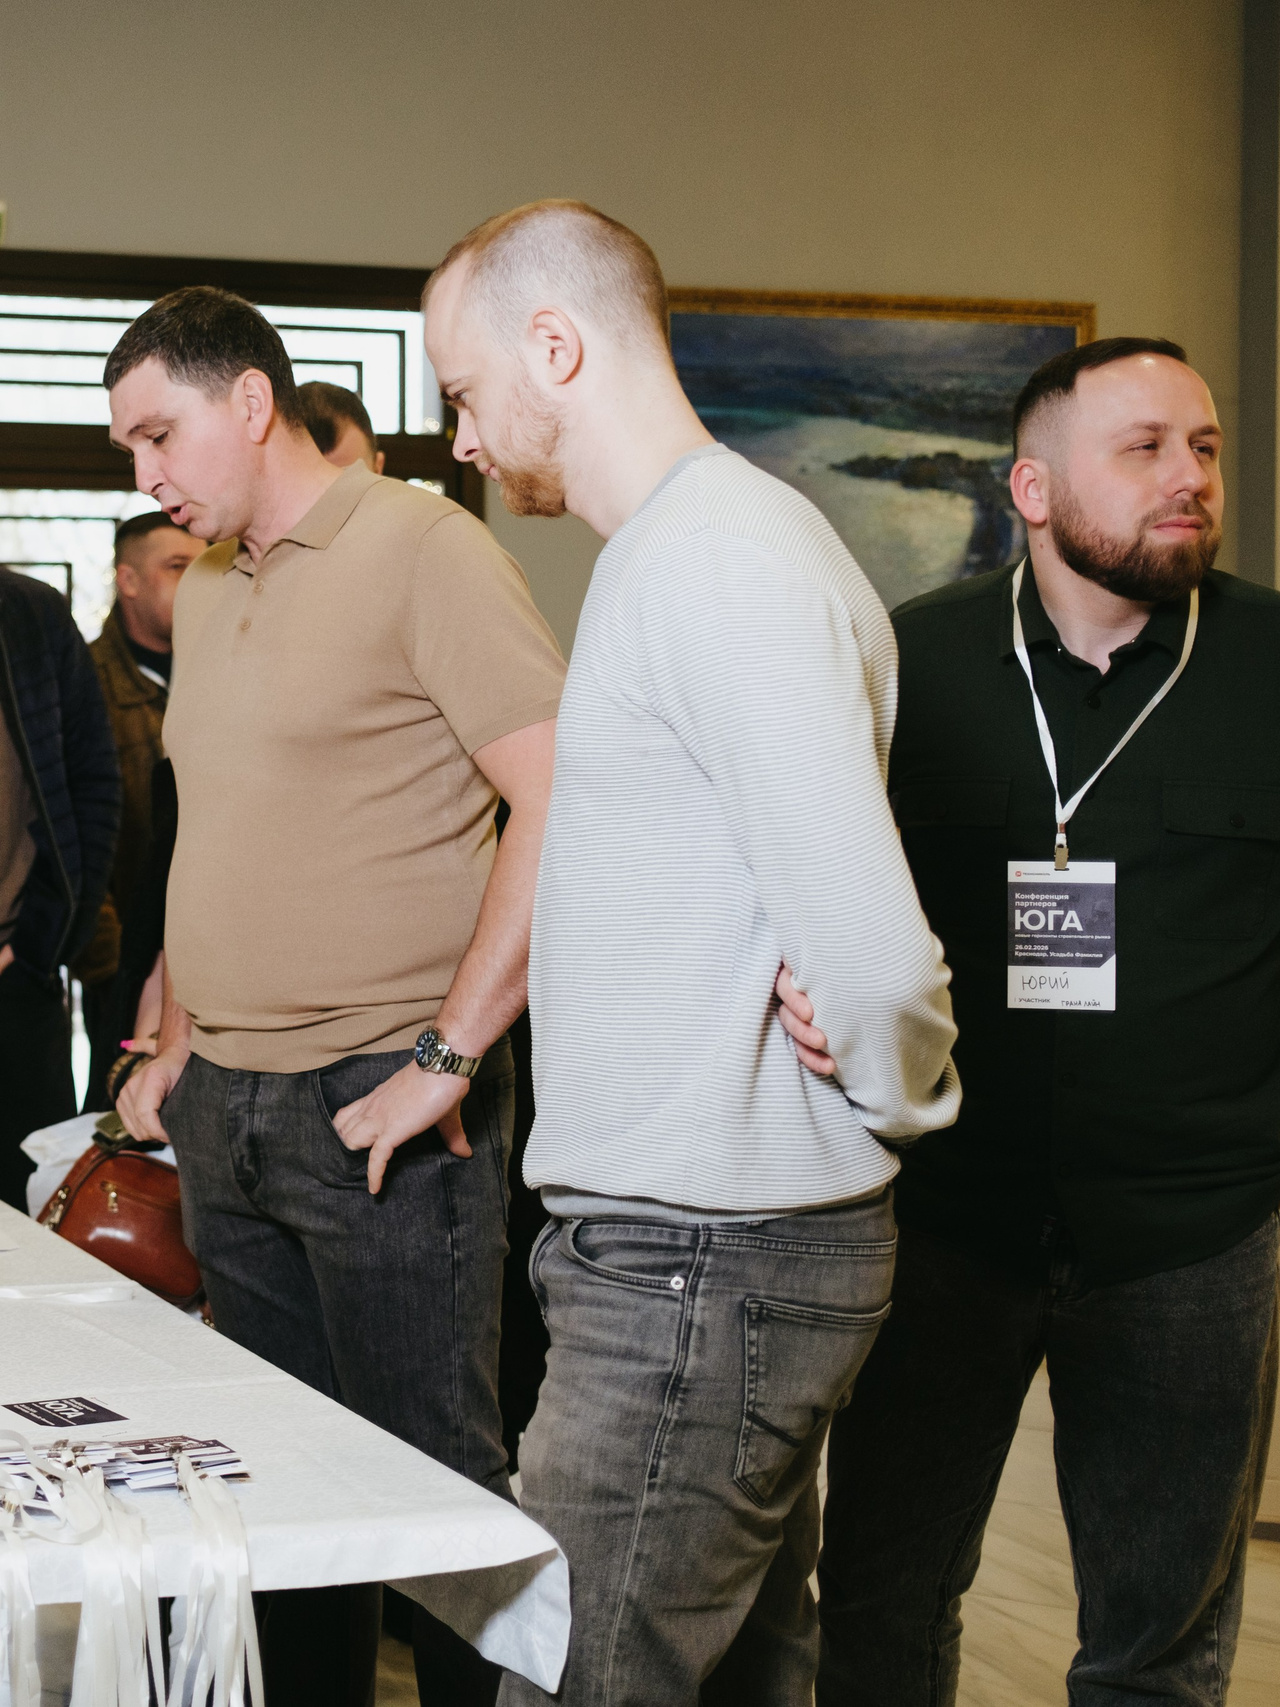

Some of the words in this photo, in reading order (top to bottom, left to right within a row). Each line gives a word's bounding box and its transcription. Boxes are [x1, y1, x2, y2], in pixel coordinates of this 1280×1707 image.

[1015, 892, 1070, 900] Конференция
[1015, 909, 1083, 931] ЮГА
[1021, 971, 1069, 990] ЮРИЙ
[38, 1400, 85, 1419] ЮГА
